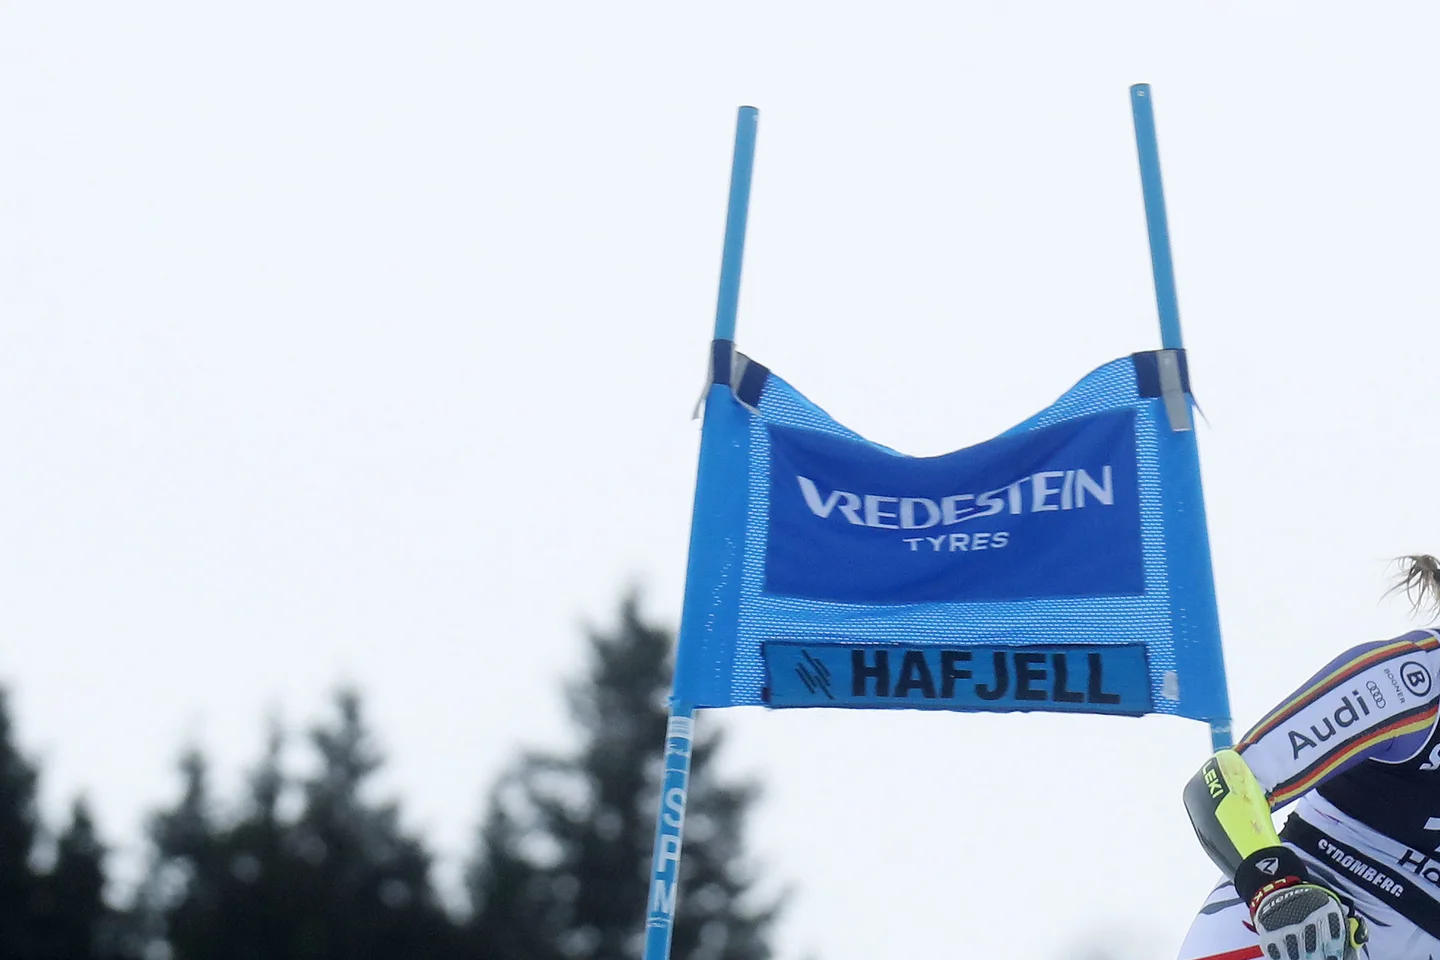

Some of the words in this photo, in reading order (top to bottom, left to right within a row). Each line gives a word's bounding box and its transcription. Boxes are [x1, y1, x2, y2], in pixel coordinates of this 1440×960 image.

[797, 464, 1114, 530] VREDESTEIN
[902, 531, 1010, 553] TYRES
[851, 648, 1122, 705] HAFJELL
[1384, 668, 1406, 704] BOGNER
[1287, 689, 1371, 760] Audi
[1202, 760, 1224, 799] LEKI
